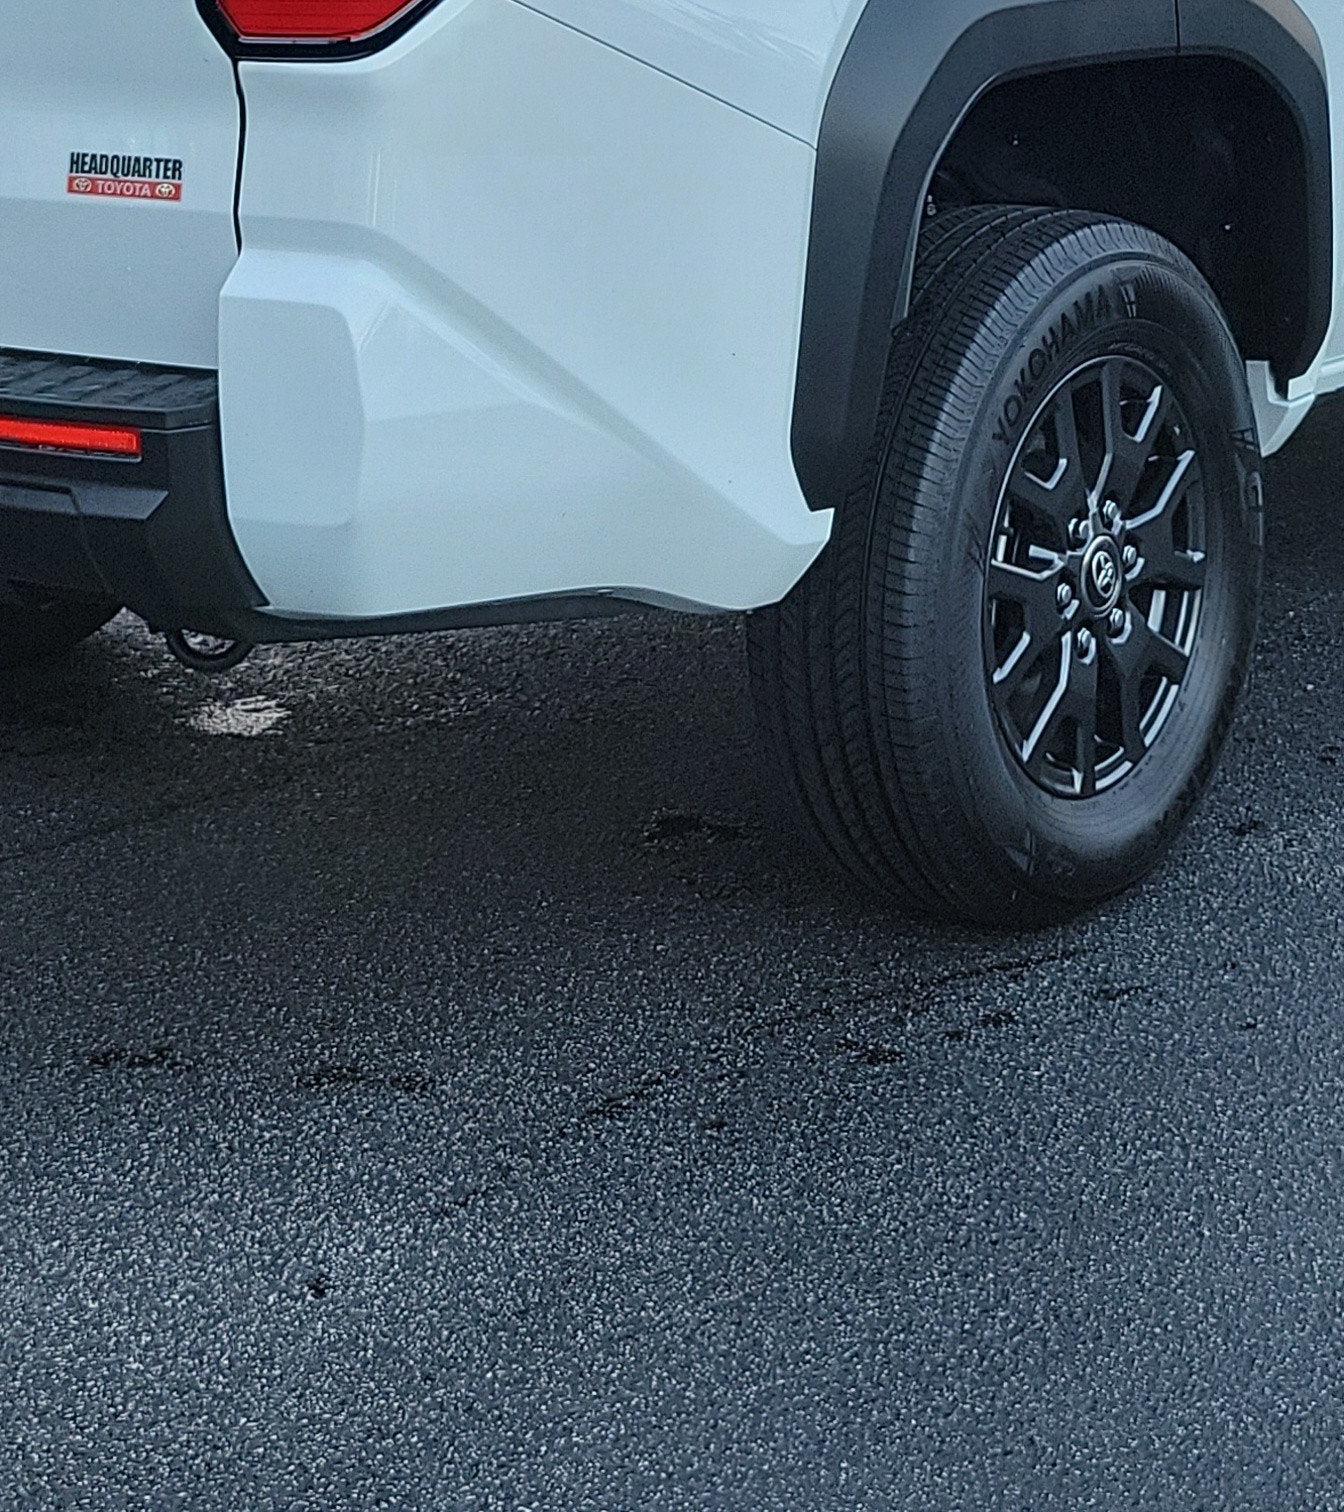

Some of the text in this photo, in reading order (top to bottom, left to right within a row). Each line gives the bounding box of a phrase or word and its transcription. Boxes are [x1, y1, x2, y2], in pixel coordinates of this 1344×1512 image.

[69, 151, 183, 180] HEADQUARTER
[96, 180, 152, 197] TOYOTA
[992, 284, 1112, 445] YOKOHAMA
